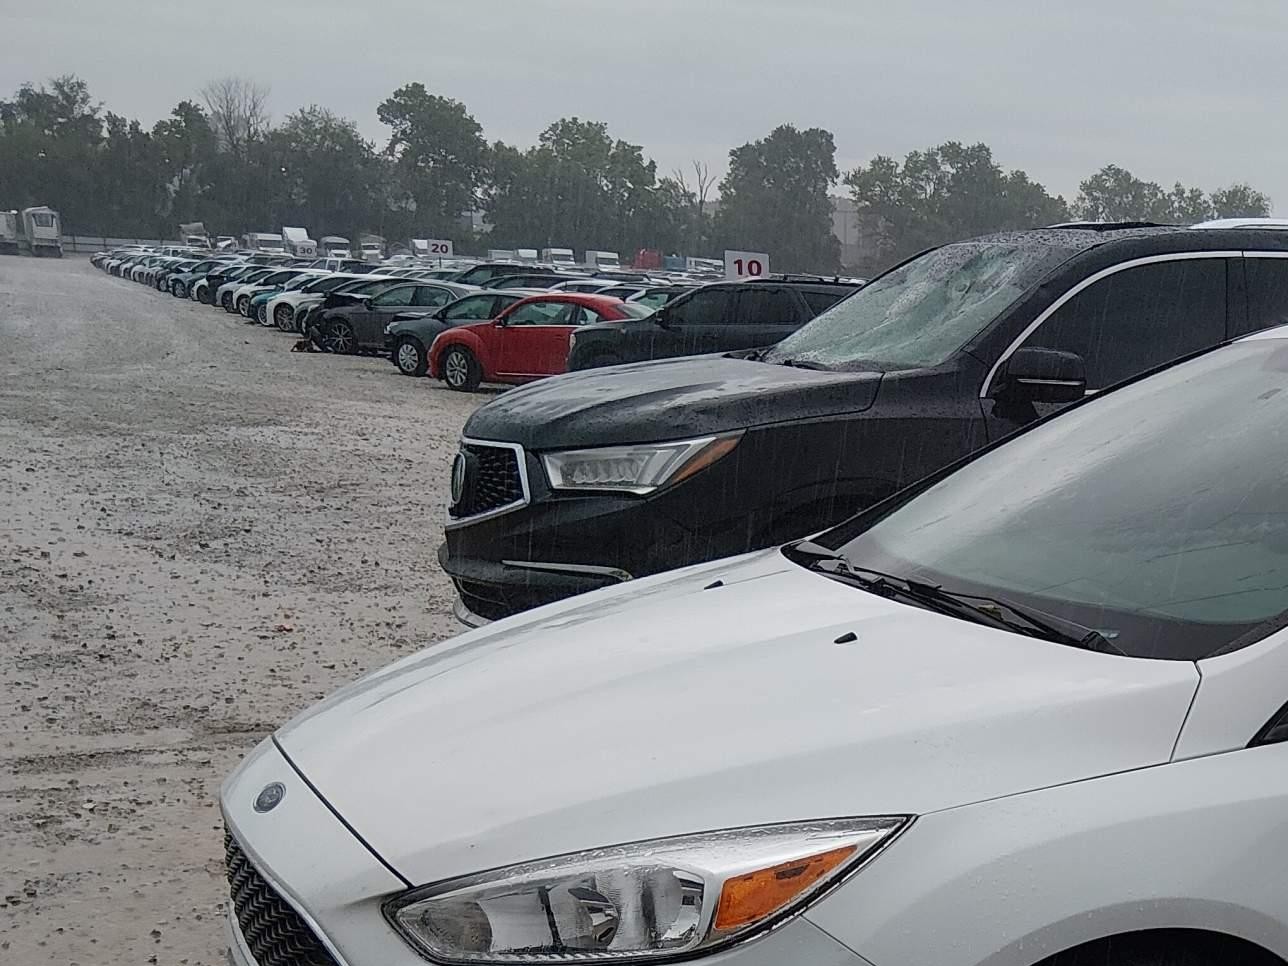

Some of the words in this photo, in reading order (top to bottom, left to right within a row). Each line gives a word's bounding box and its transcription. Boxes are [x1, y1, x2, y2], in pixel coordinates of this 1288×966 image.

[299, 246, 313, 255] 30
[431, 243, 449, 254] 20
[733, 259, 762, 277] 10
